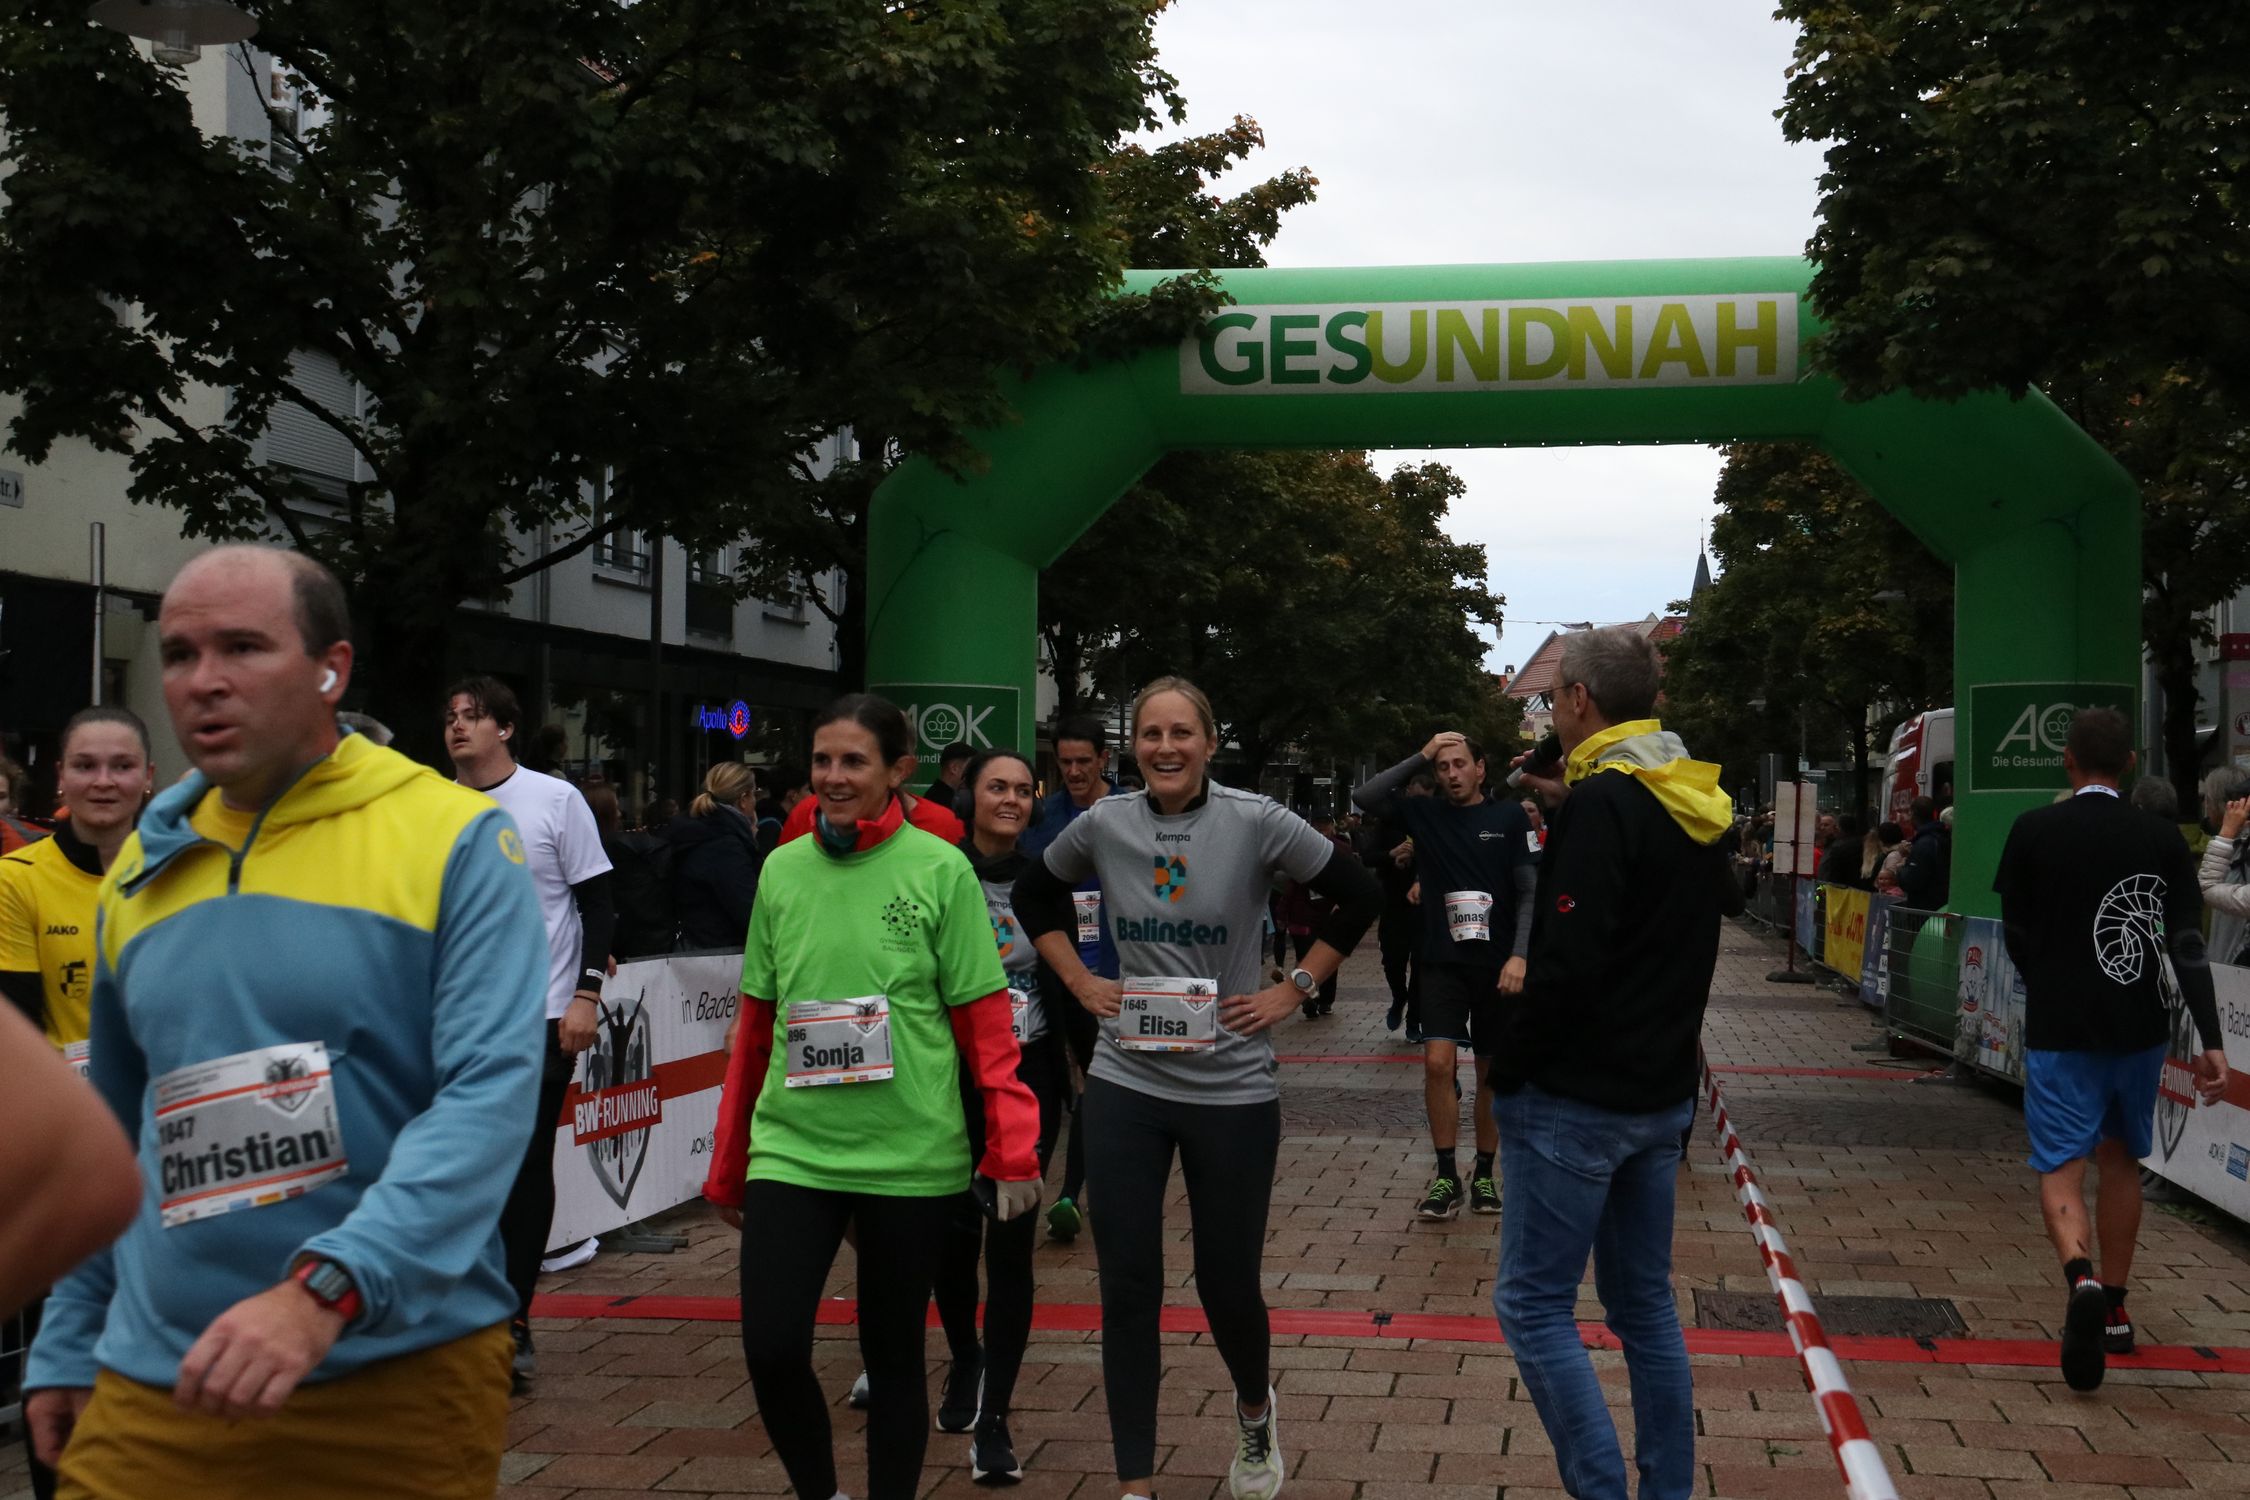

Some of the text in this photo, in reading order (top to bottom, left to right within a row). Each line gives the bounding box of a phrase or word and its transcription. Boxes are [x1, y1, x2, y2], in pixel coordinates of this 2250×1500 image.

[1199, 301, 1777, 386] GESUNDNAH
[0, 476, 12, 497] tr.
[699, 704, 727, 735] Apollo
[1992, 756, 2009, 768] Die
[1155, 832, 1191, 843] Kempa
[1453, 913, 1484, 924] Jonas
[46, 925, 79, 935] JAKO
[1116, 917, 1228, 947] Balingen
[681, 991, 693, 1024] in
[1123, 999, 1148, 1011] 1645
[787, 1028, 806, 1042] 896
[1138, 1015, 1188, 1036] Elisa
[802, 1042, 865, 1069] Sonja
[575, 1086, 659, 1136] BW-RUNNING
[159, 1116, 196, 1146] 1847
[162, 1128, 330, 1194] Christian
[2105, 1324, 2131, 1336] PUMA
